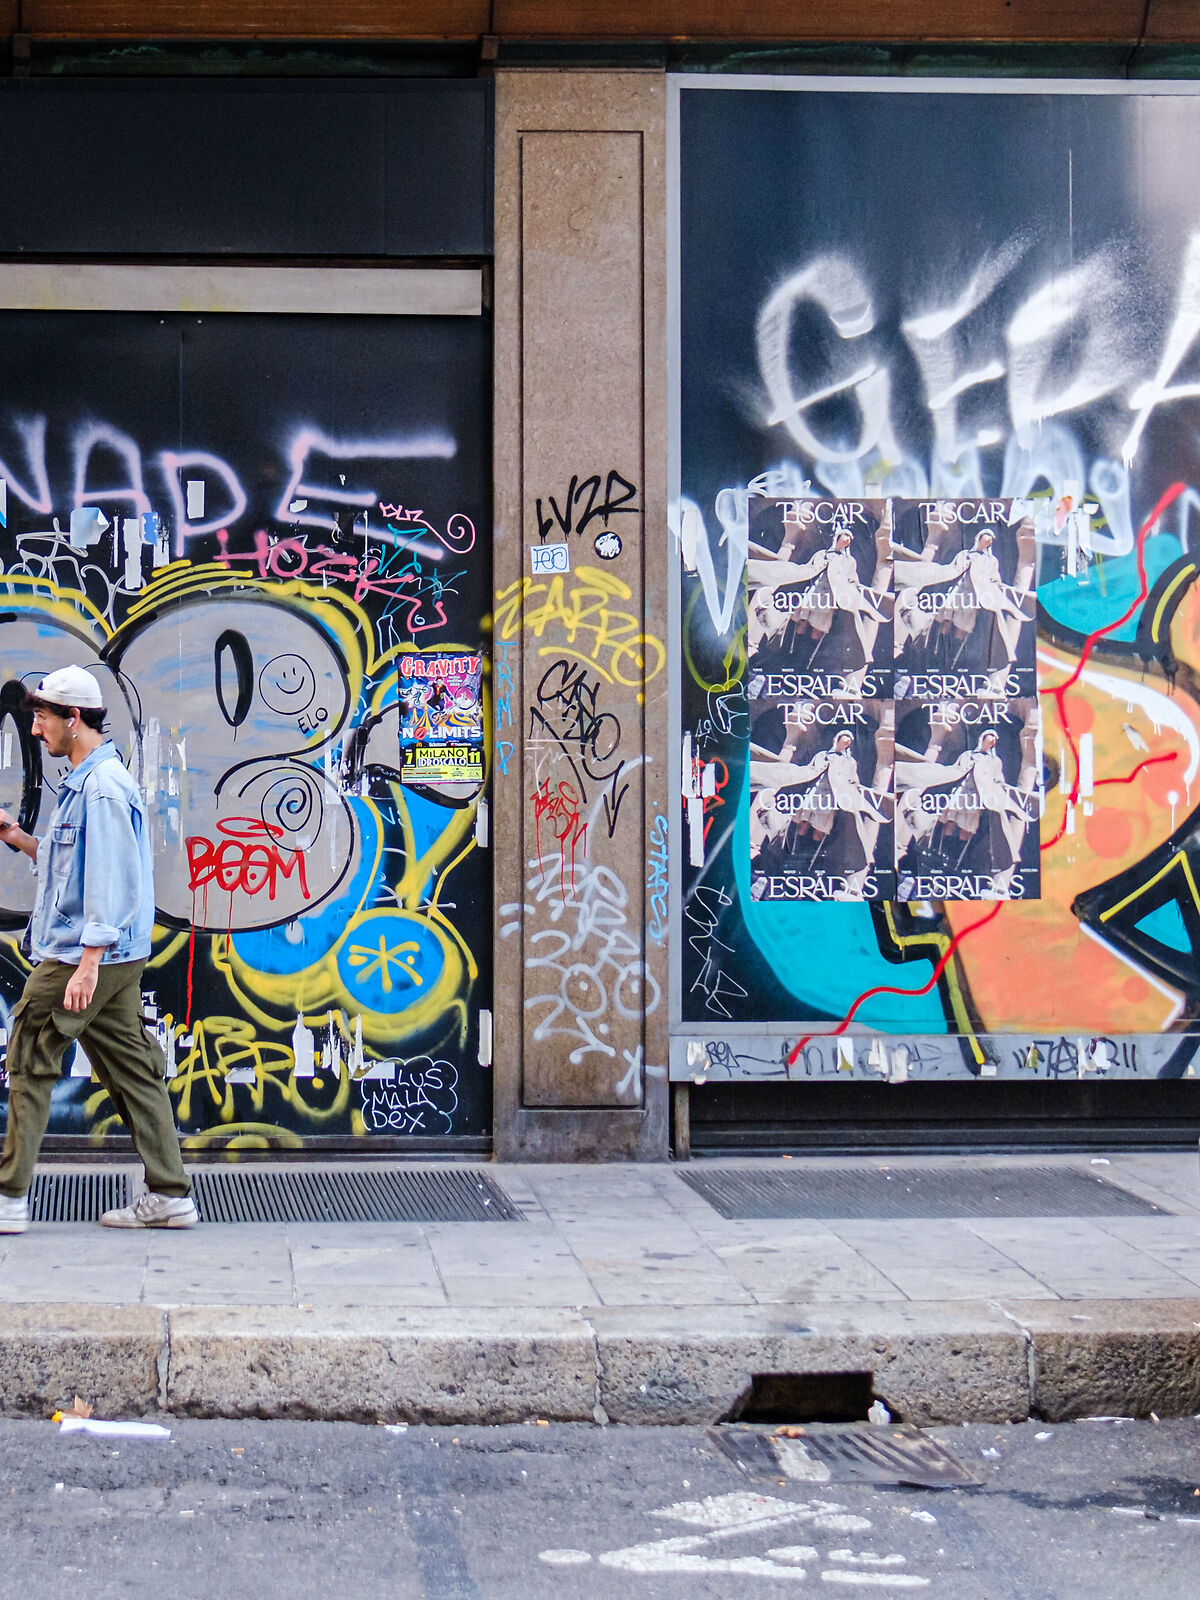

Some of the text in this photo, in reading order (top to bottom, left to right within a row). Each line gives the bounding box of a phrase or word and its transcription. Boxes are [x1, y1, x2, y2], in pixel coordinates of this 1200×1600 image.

[775, 501, 868, 525] TISCAR
[918, 501, 1009, 526] TISCAR
[401, 656, 481, 677] GRAVITY
[766, 674, 877, 699] ESPADAS
[911, 674, 1021, 699] ESPADAS
[776, 702, 868, 725] TISCAR
[921, 702, 1012, 725] TISCAR
[428, 726, 481, 739] LIMITS
[405, 752, 413, 765] 7
[468, 751, 481, 764] 11
[768, 875, 879, 901] ESPADAS
[915, 874, 1025, 900] ESPADAS
